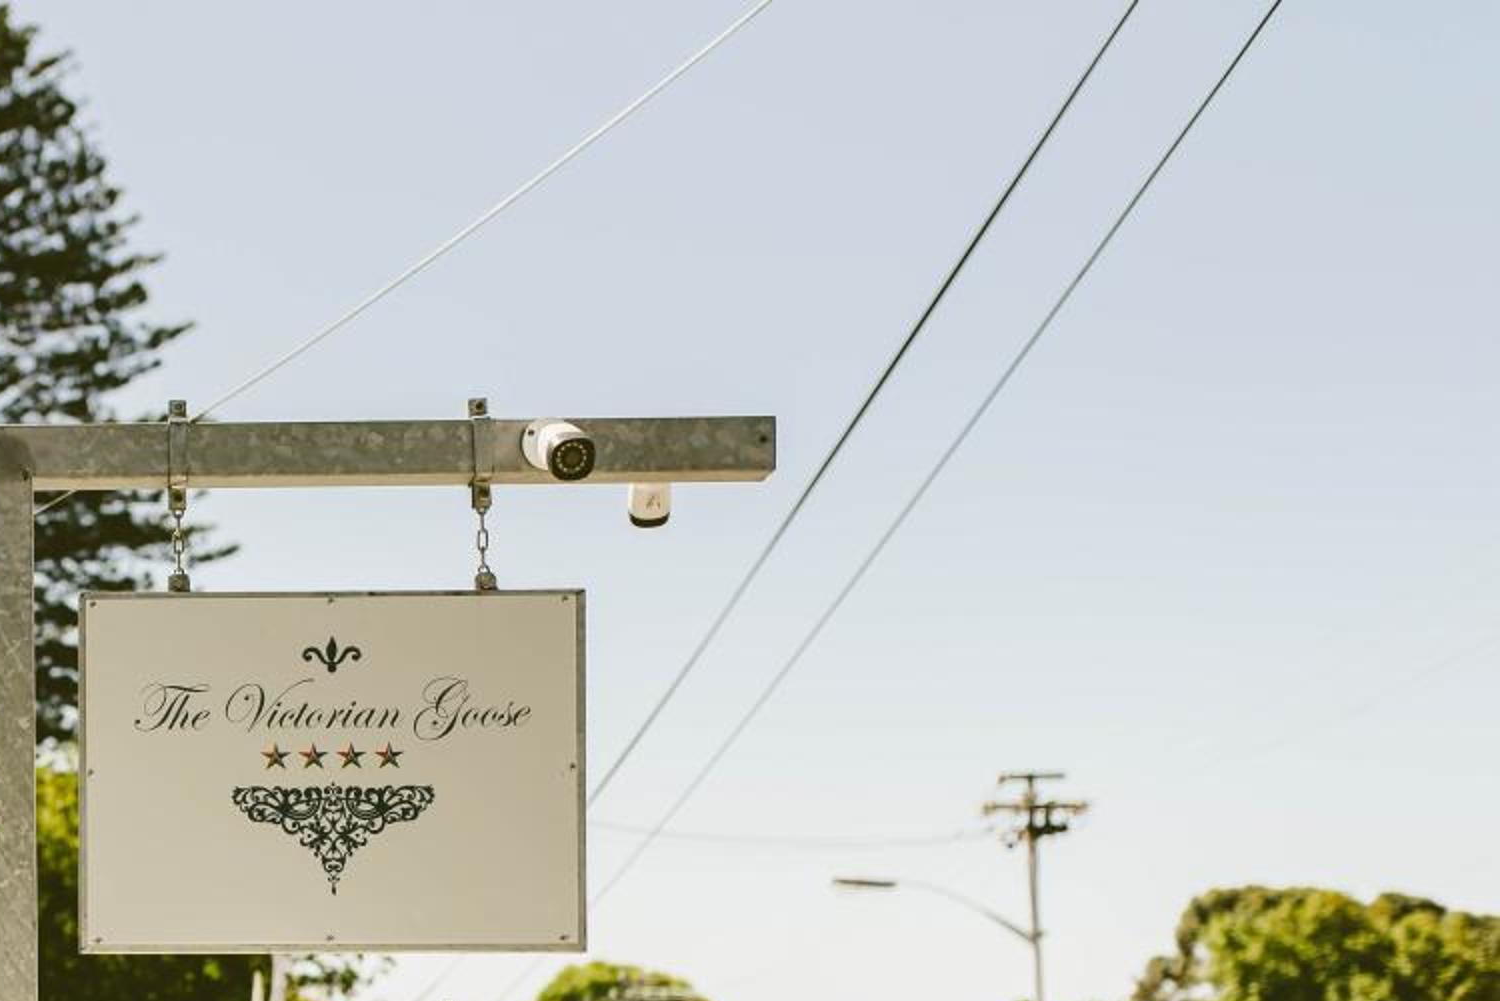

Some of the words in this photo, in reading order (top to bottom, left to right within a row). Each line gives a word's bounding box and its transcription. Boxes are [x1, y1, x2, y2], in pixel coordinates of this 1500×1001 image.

[134, 683, 211, 732] The
[225, 678, 401, 733] Victorian
[414, 676, 532, 741] Goose
